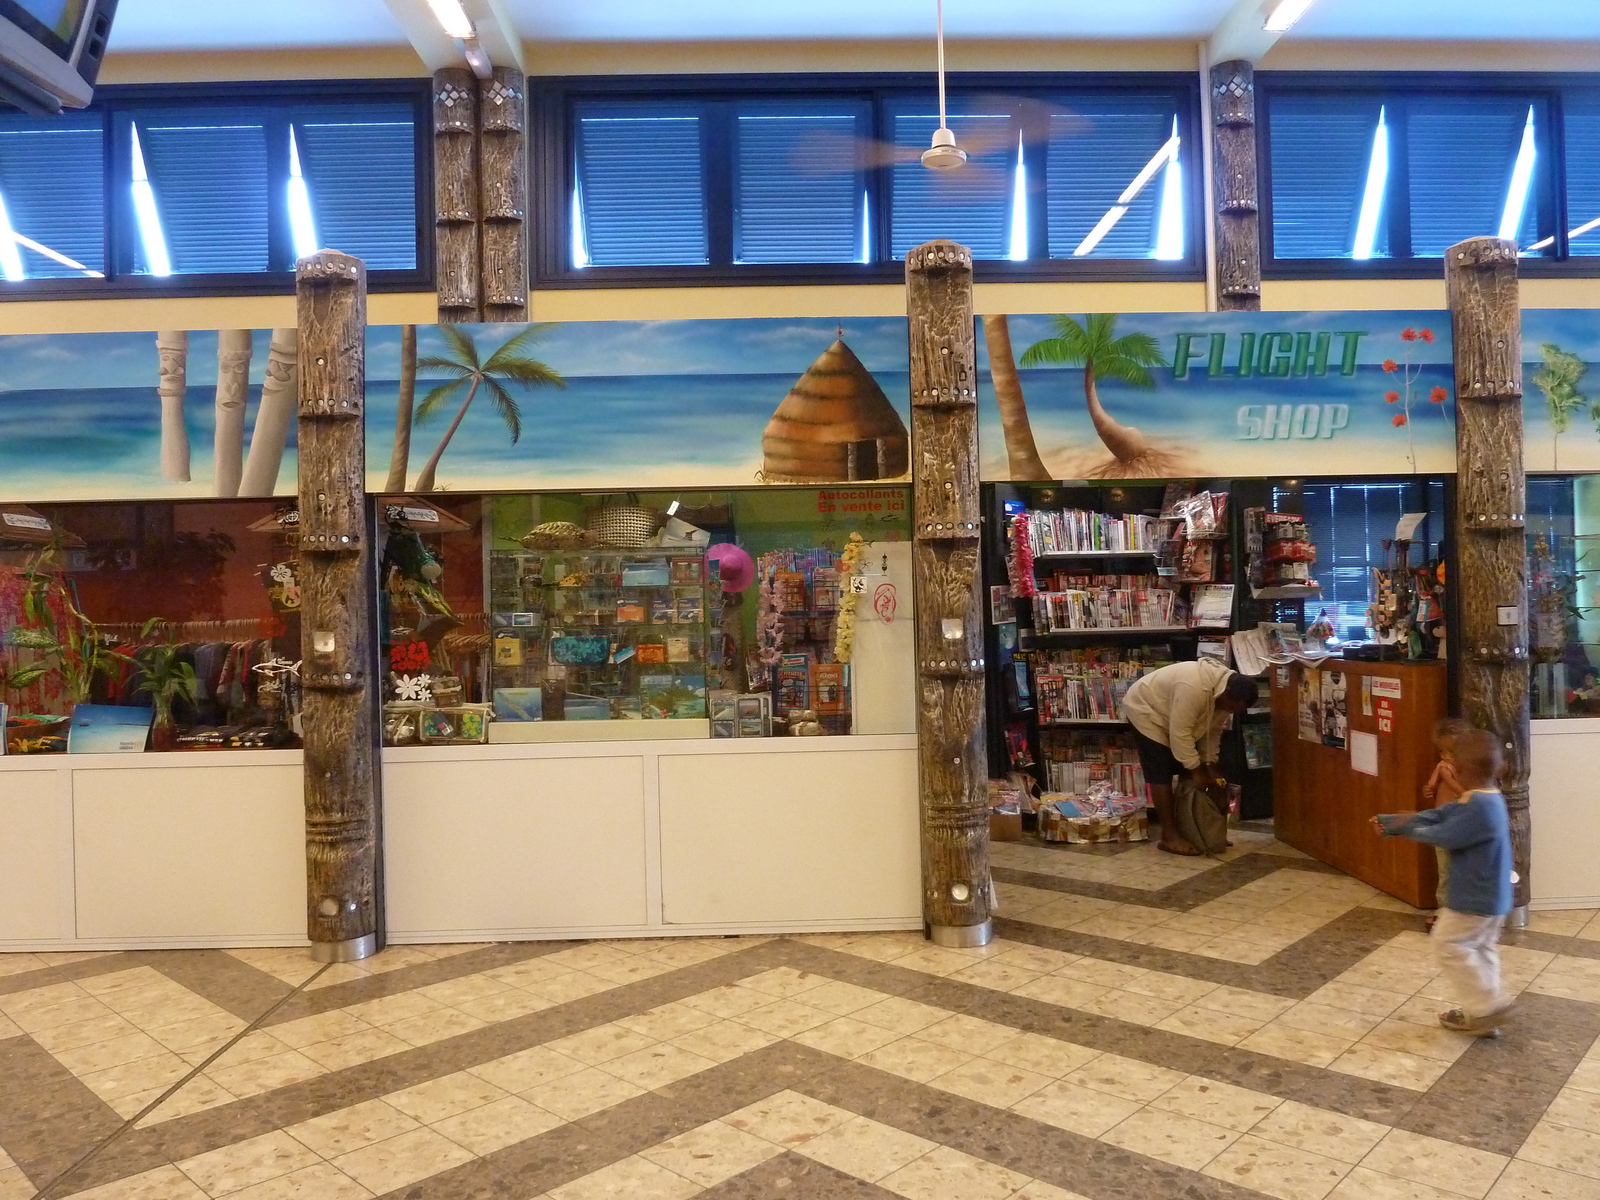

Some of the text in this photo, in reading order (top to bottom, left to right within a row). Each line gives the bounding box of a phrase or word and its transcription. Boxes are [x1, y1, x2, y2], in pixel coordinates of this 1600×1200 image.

[1173, 330, 1369, 380] FLIGHT
[1235, 403, 1350, 440] SHOP
[817, 488, 904, 501] Autocollants
[817, 500, 905, 513] En vente ici
[1379, 718, 1391, 732] ICI
